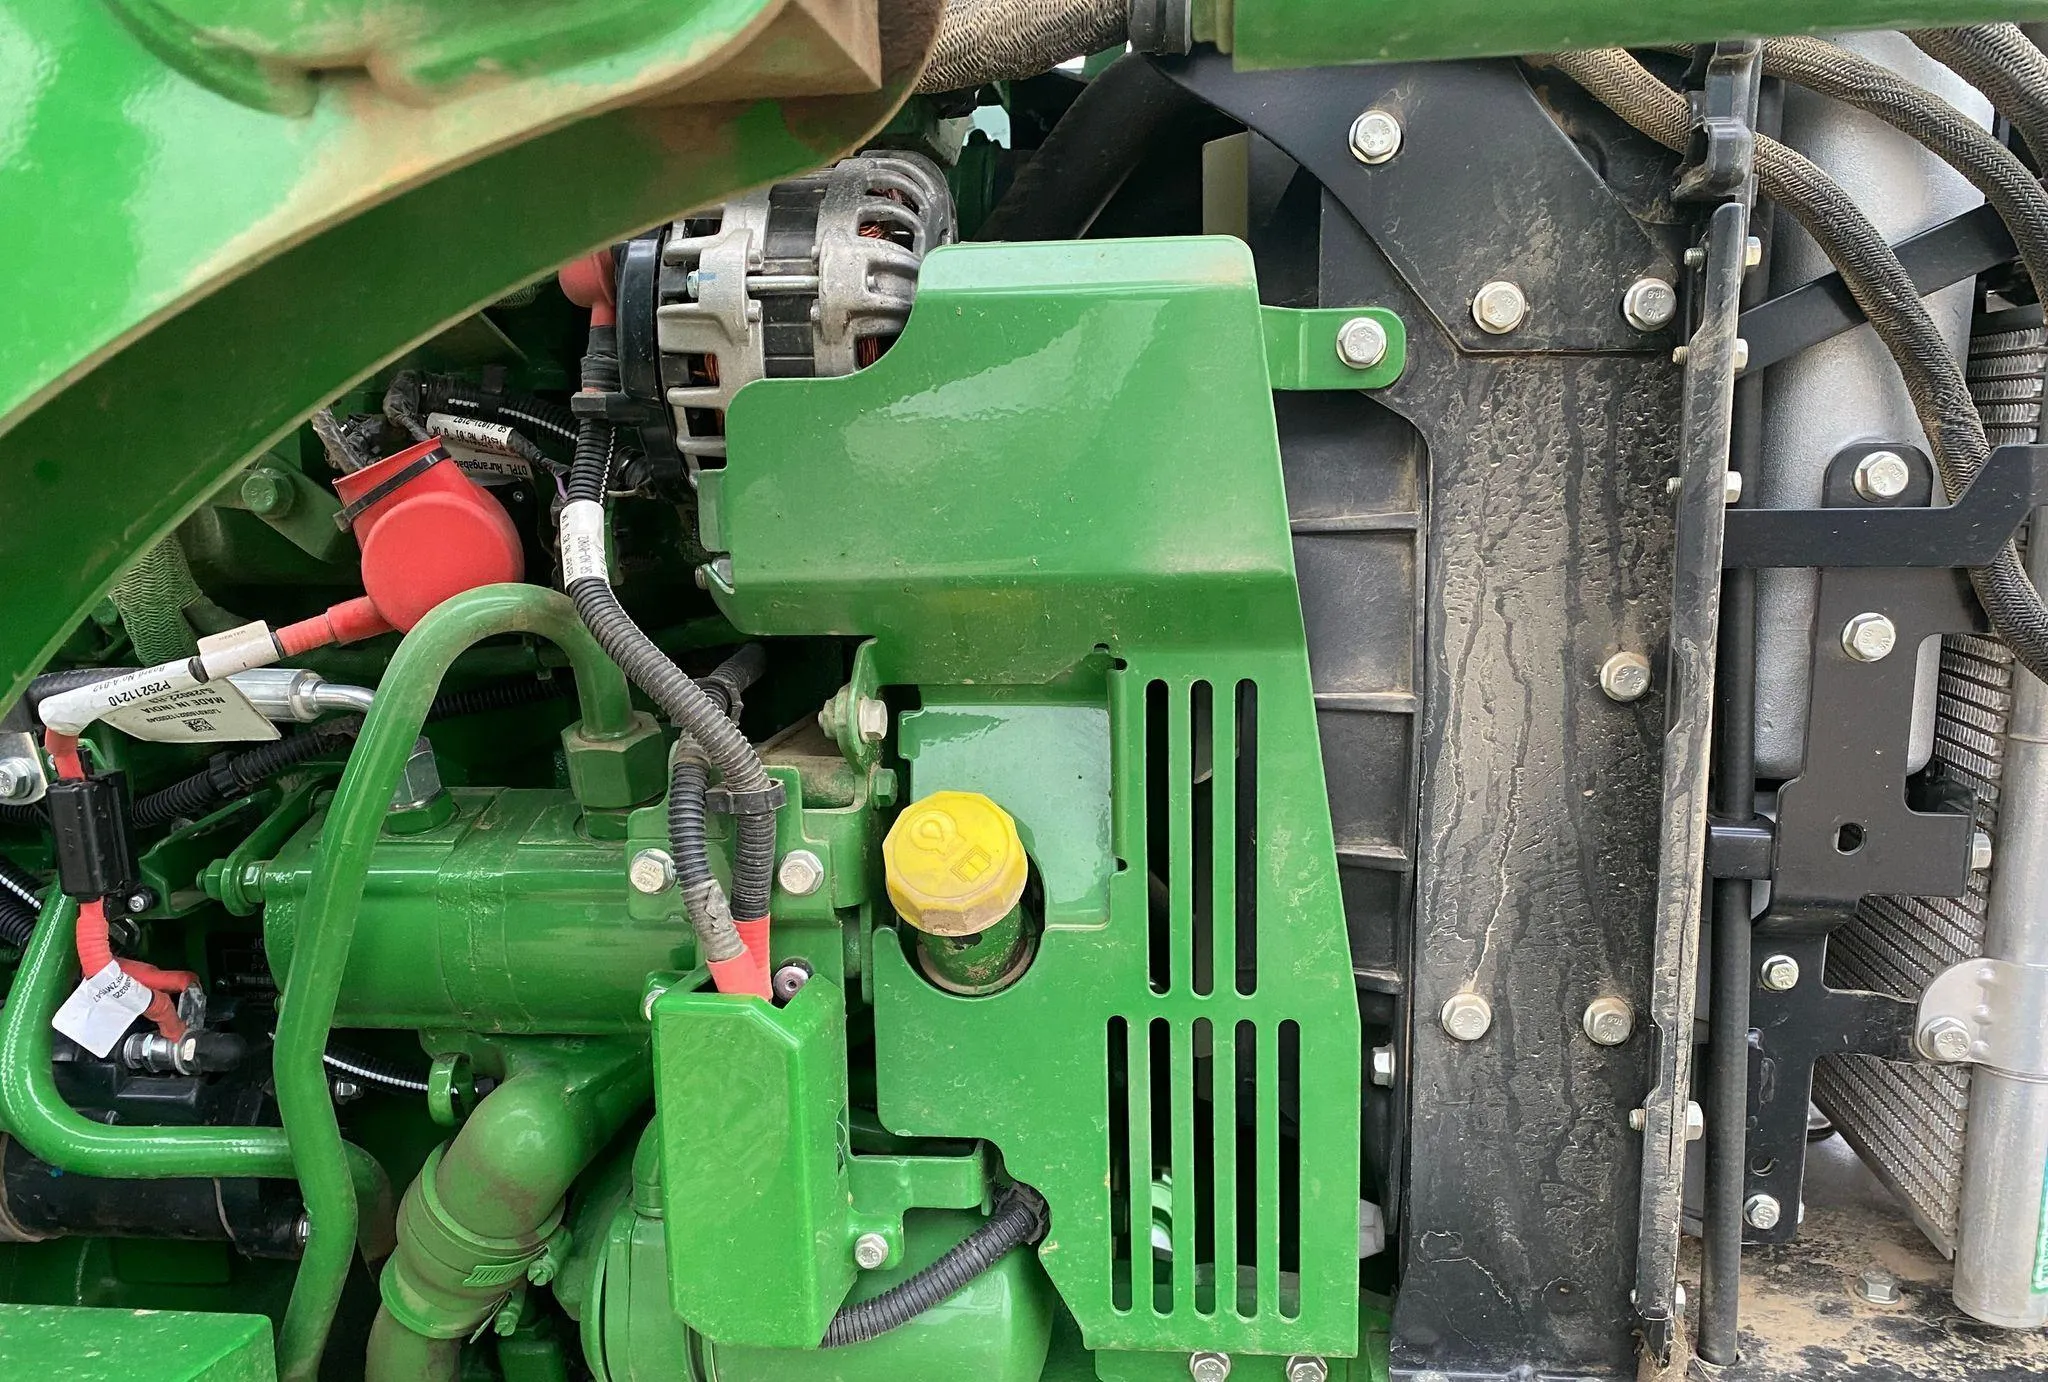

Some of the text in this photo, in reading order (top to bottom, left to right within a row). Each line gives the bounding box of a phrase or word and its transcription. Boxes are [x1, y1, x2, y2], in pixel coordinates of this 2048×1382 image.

[107, 679, 172, 707] P25211210
[194, 696, 227, 707] MADE
[140, 704, 177, 715] INDIA
